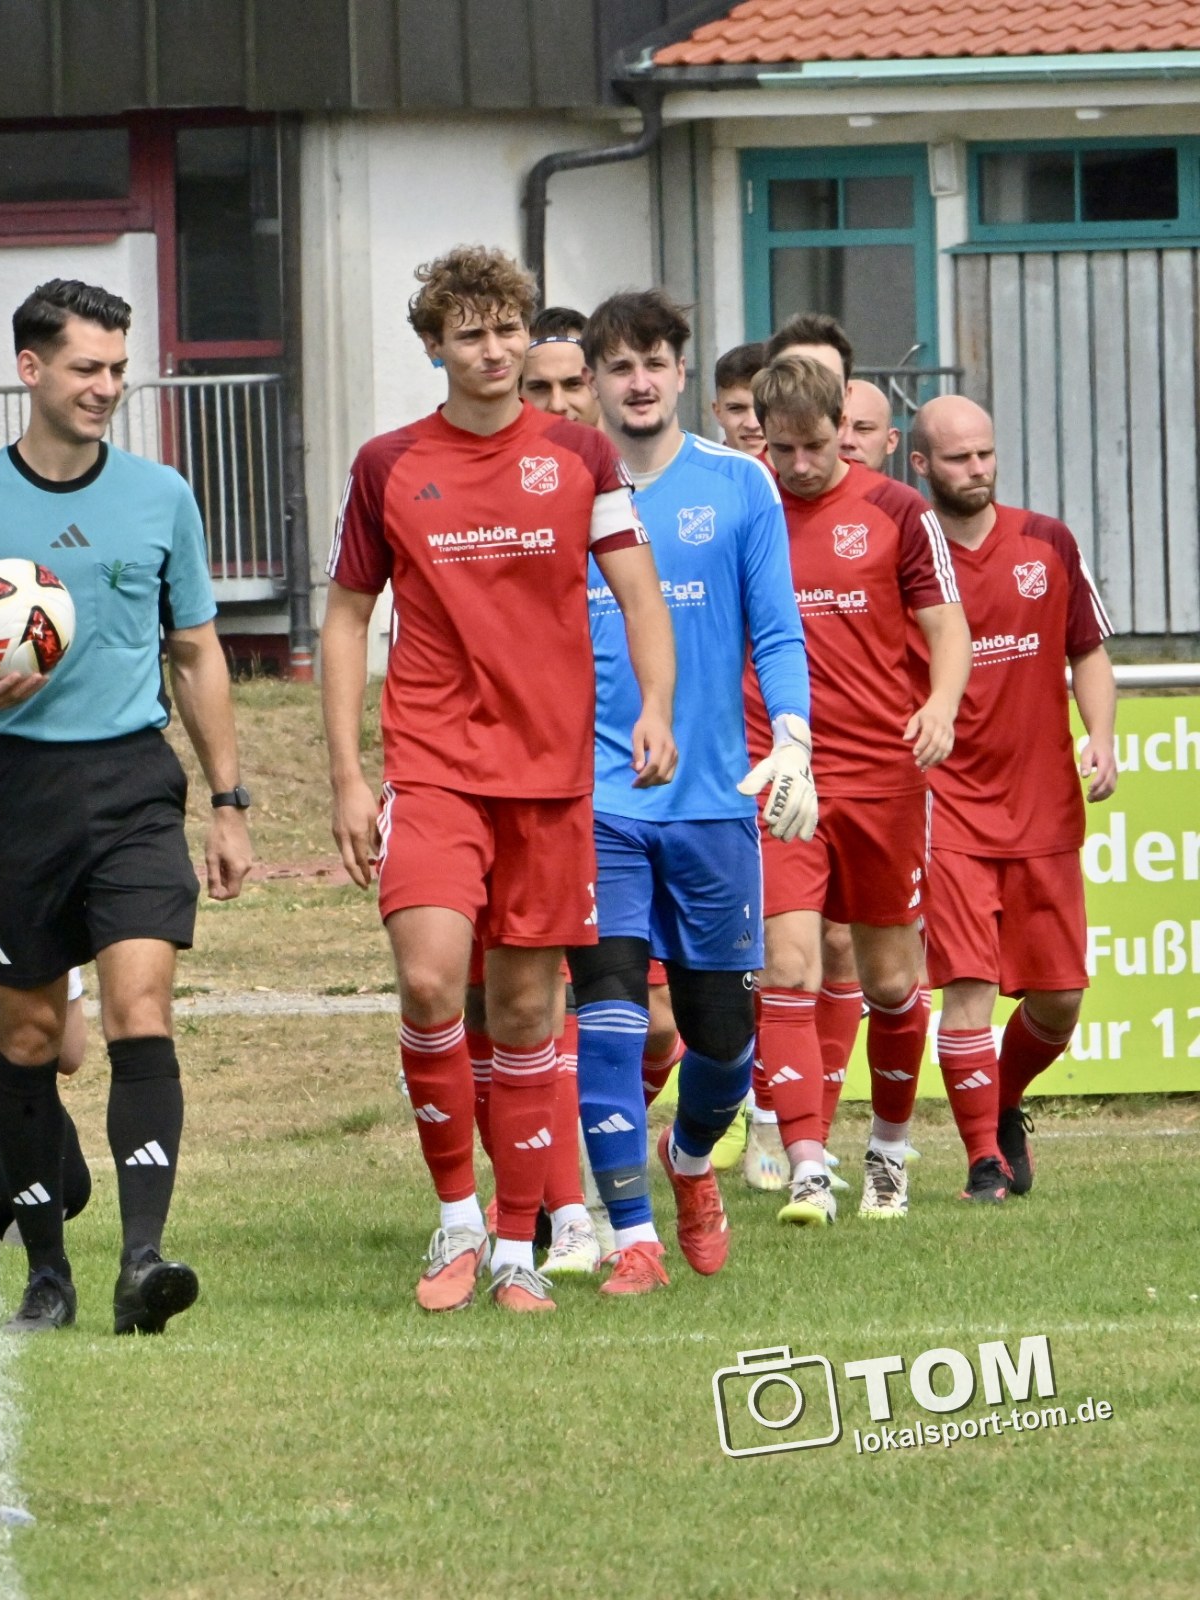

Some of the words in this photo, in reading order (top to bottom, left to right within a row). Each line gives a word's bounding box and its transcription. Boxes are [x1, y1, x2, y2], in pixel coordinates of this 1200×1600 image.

[524, 460, 556, 487] FUCHSTAL
[427, 526, 517, 547] WALDHÖR
[743, 904, 750, 918] 1
